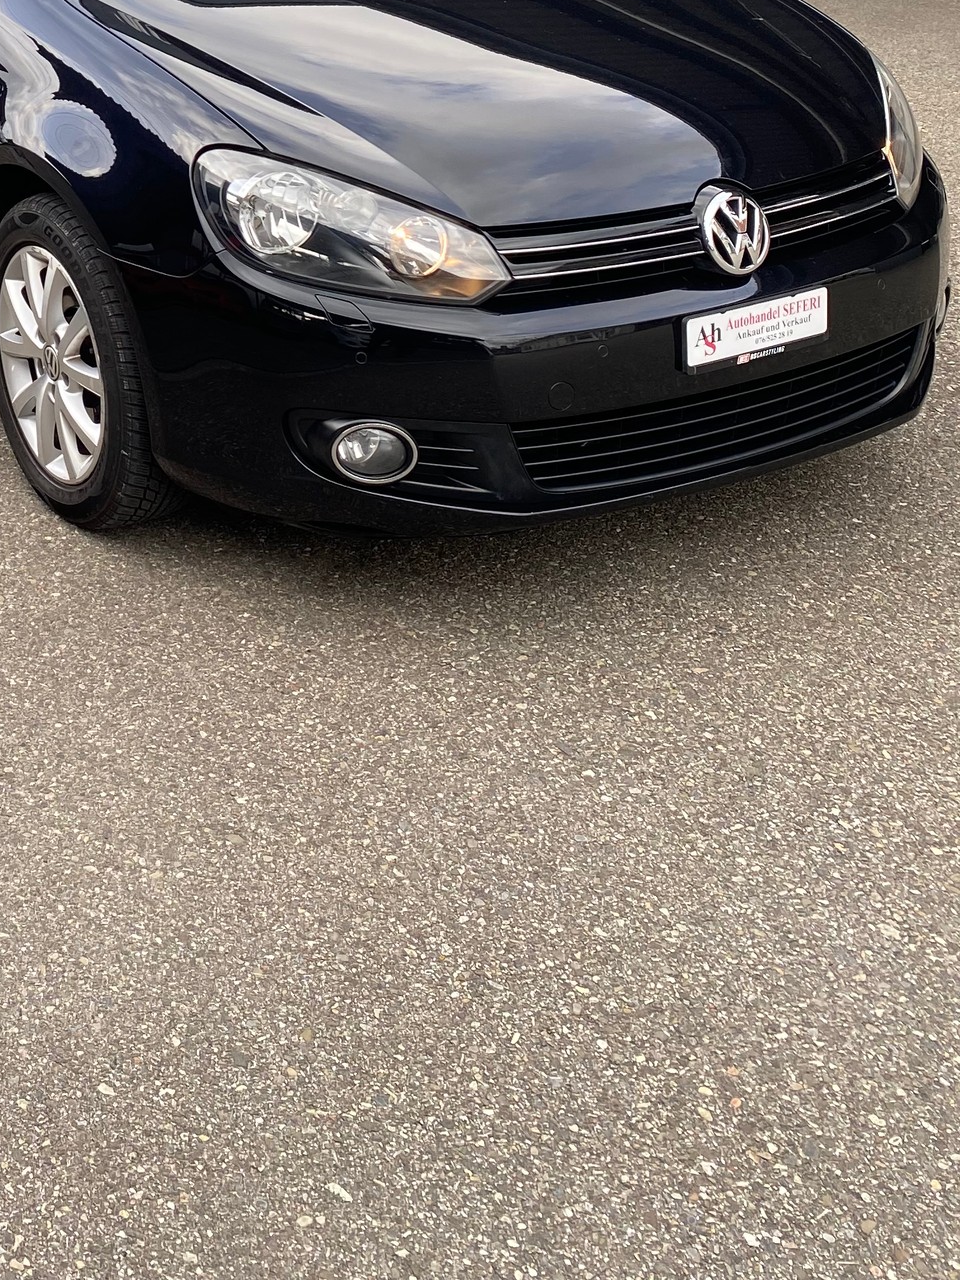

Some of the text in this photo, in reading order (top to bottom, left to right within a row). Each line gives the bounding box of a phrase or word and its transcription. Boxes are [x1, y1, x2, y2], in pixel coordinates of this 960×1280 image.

[725, 295, 821, 331] Autohandel SEFERI
[736, 314, 812, 340] Ankauf und Verkauf
